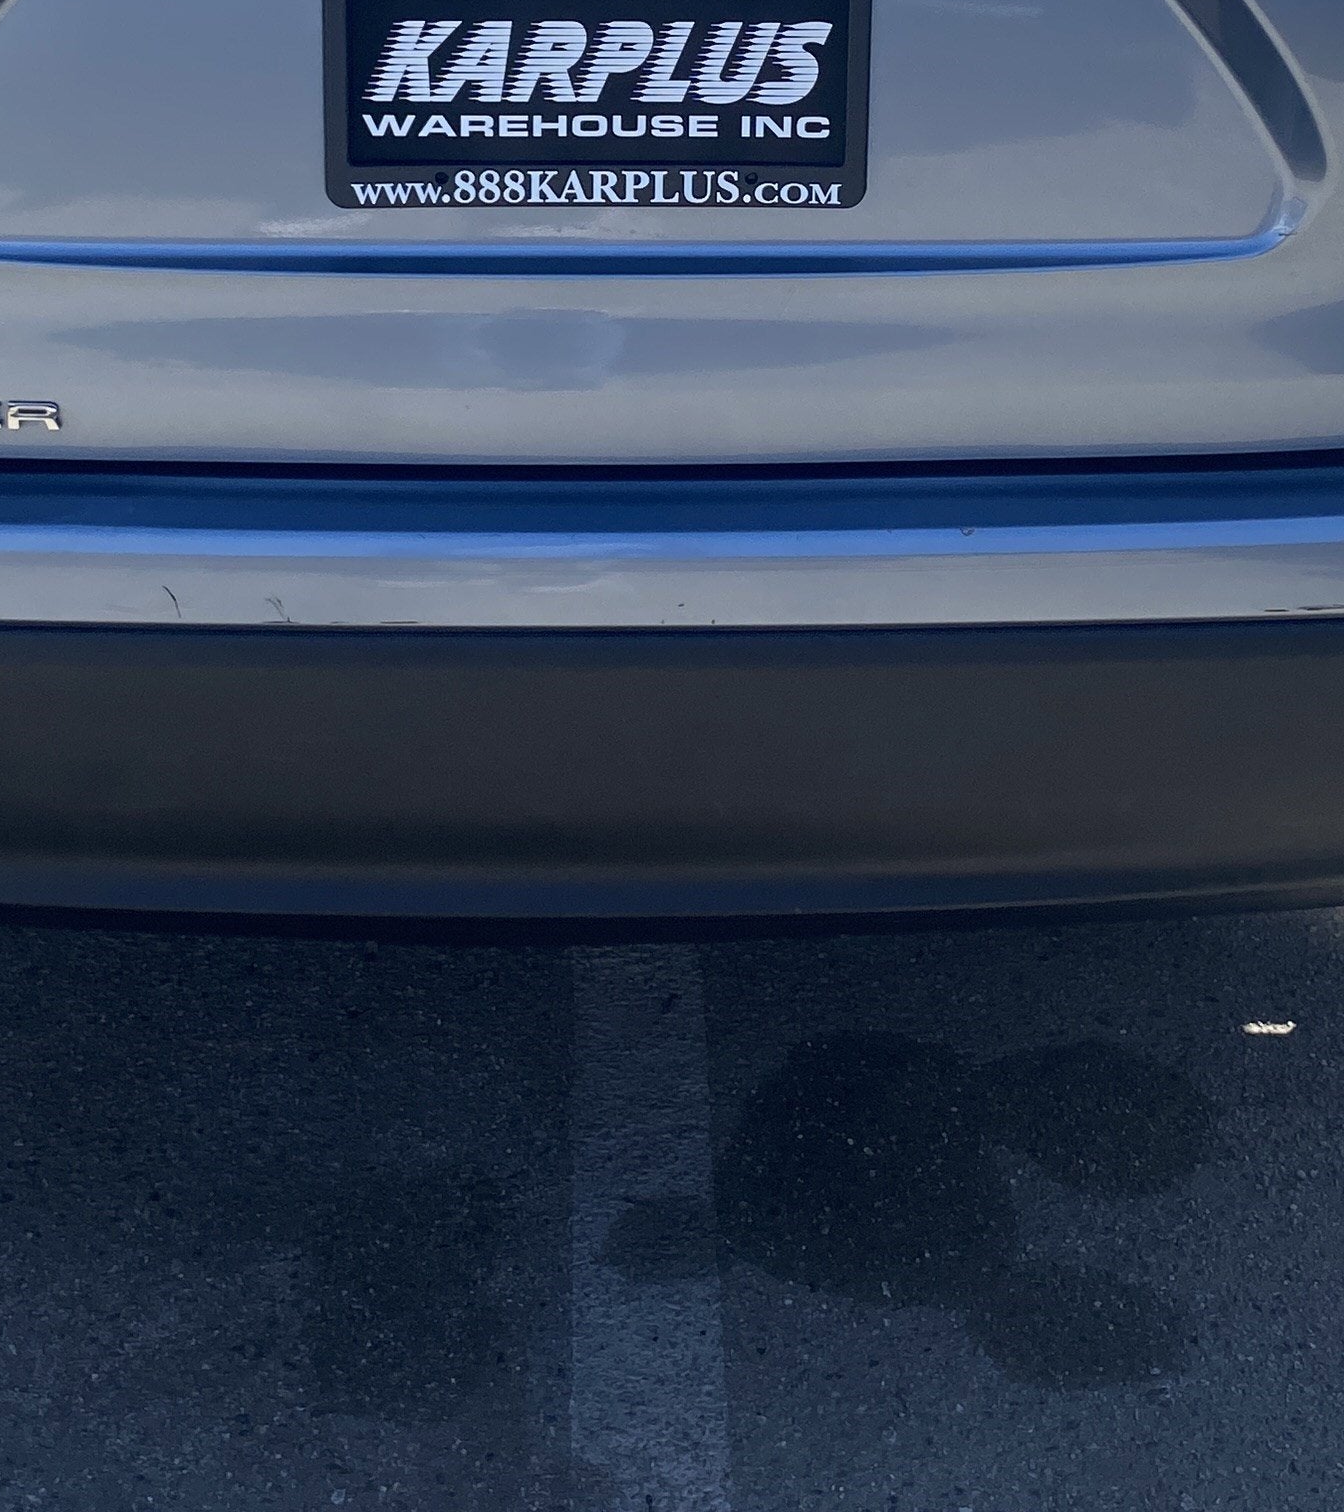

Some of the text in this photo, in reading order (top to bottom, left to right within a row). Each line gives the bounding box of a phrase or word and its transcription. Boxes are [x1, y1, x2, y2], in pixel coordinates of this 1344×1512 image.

[361, 20, 834, 105] KARPLUS
[361, 114, 832, 139] WAREHOUSE INC
